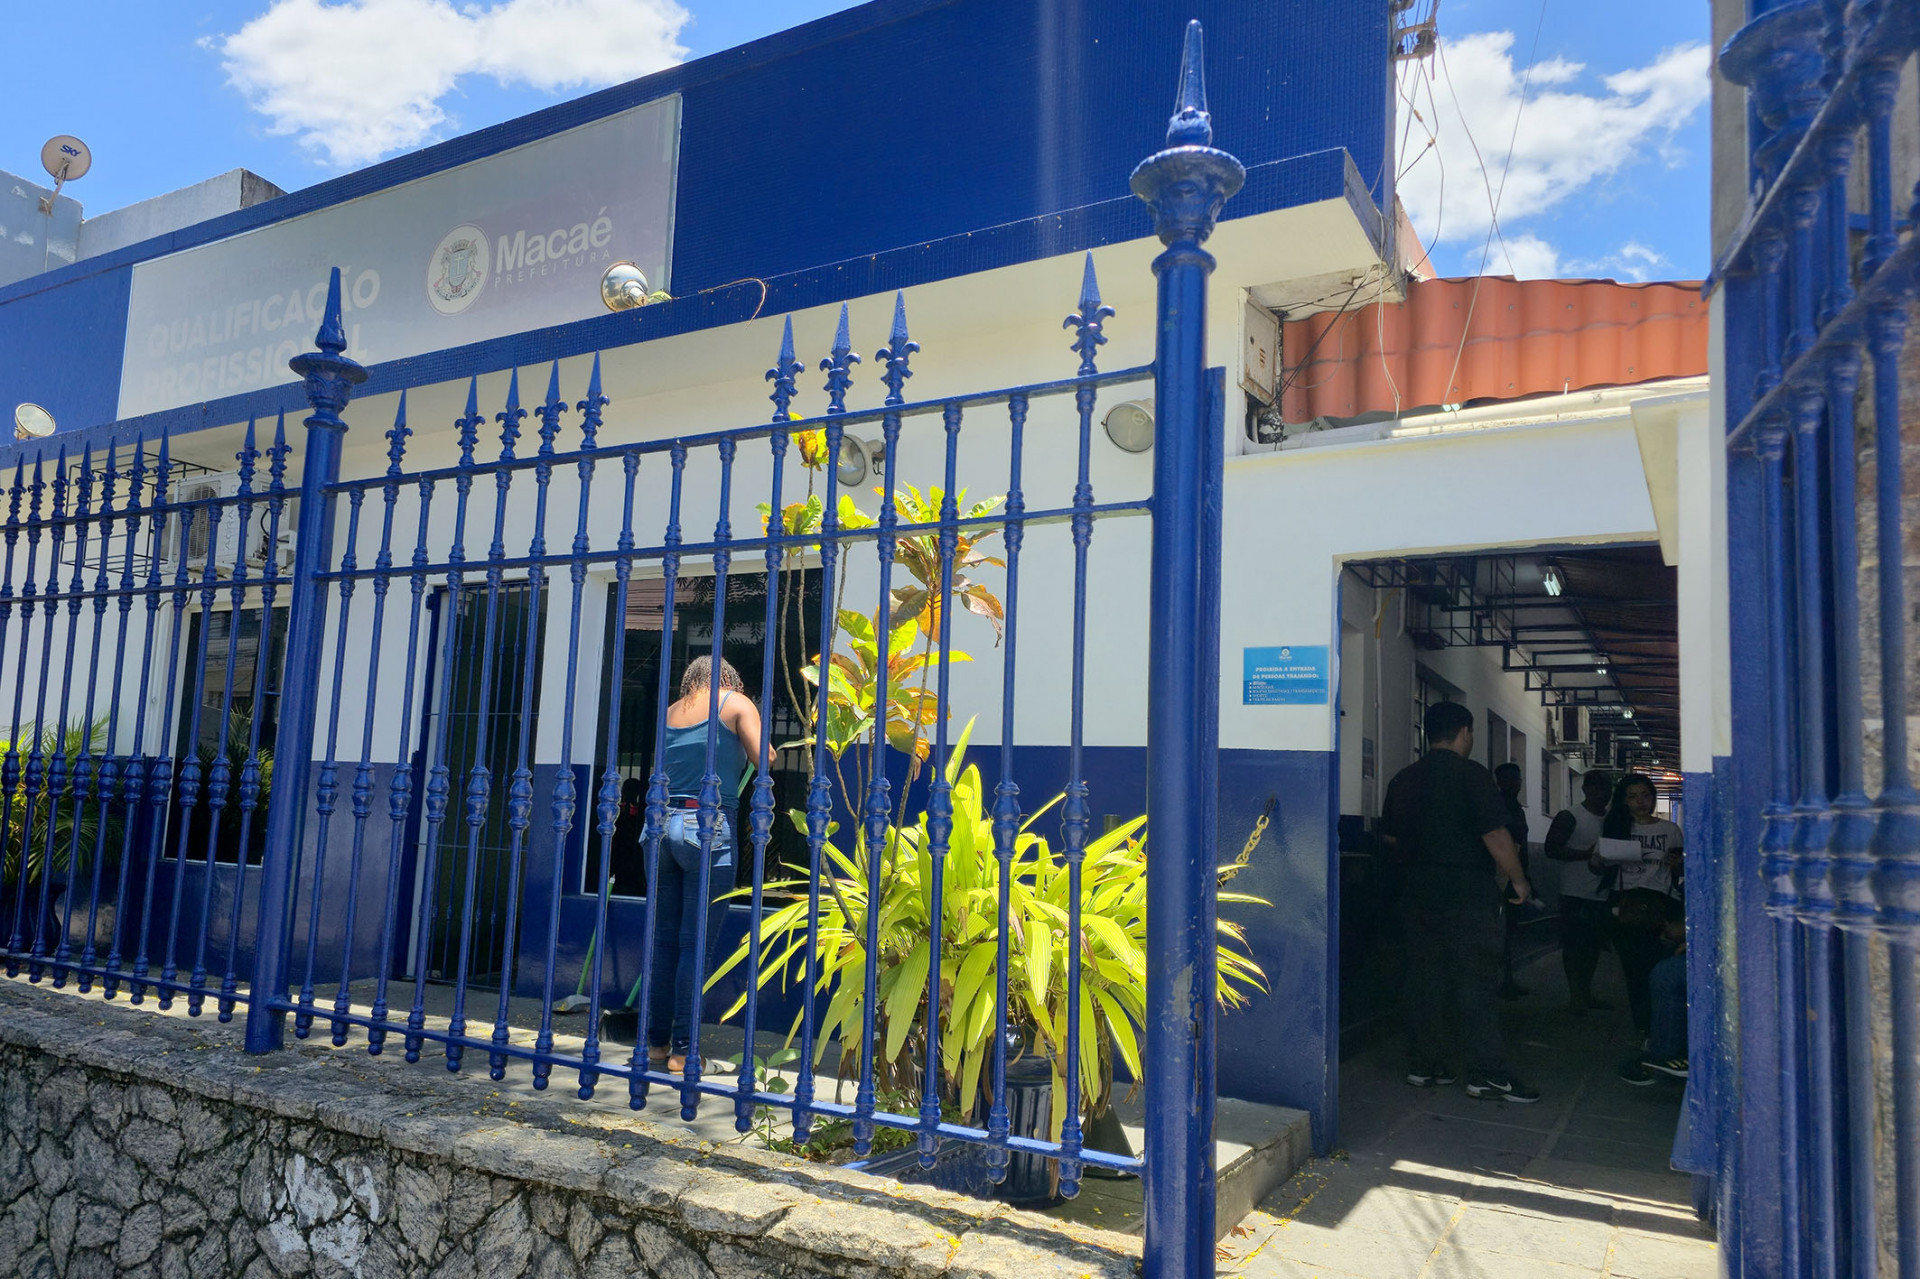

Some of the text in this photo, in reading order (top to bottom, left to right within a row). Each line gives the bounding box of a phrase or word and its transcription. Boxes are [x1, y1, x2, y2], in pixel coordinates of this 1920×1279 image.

[60, 144, 82, 157] SKY
[494, 249, 611, 288] PREFEITURA
[495, 206, 613, 274] Macaé
[147, 264, 381, 357] QUALIFICAÇÃO
[142, 324, 368, 403] PROFISSIOL
[224, 484, 237, 551] AGRAO
